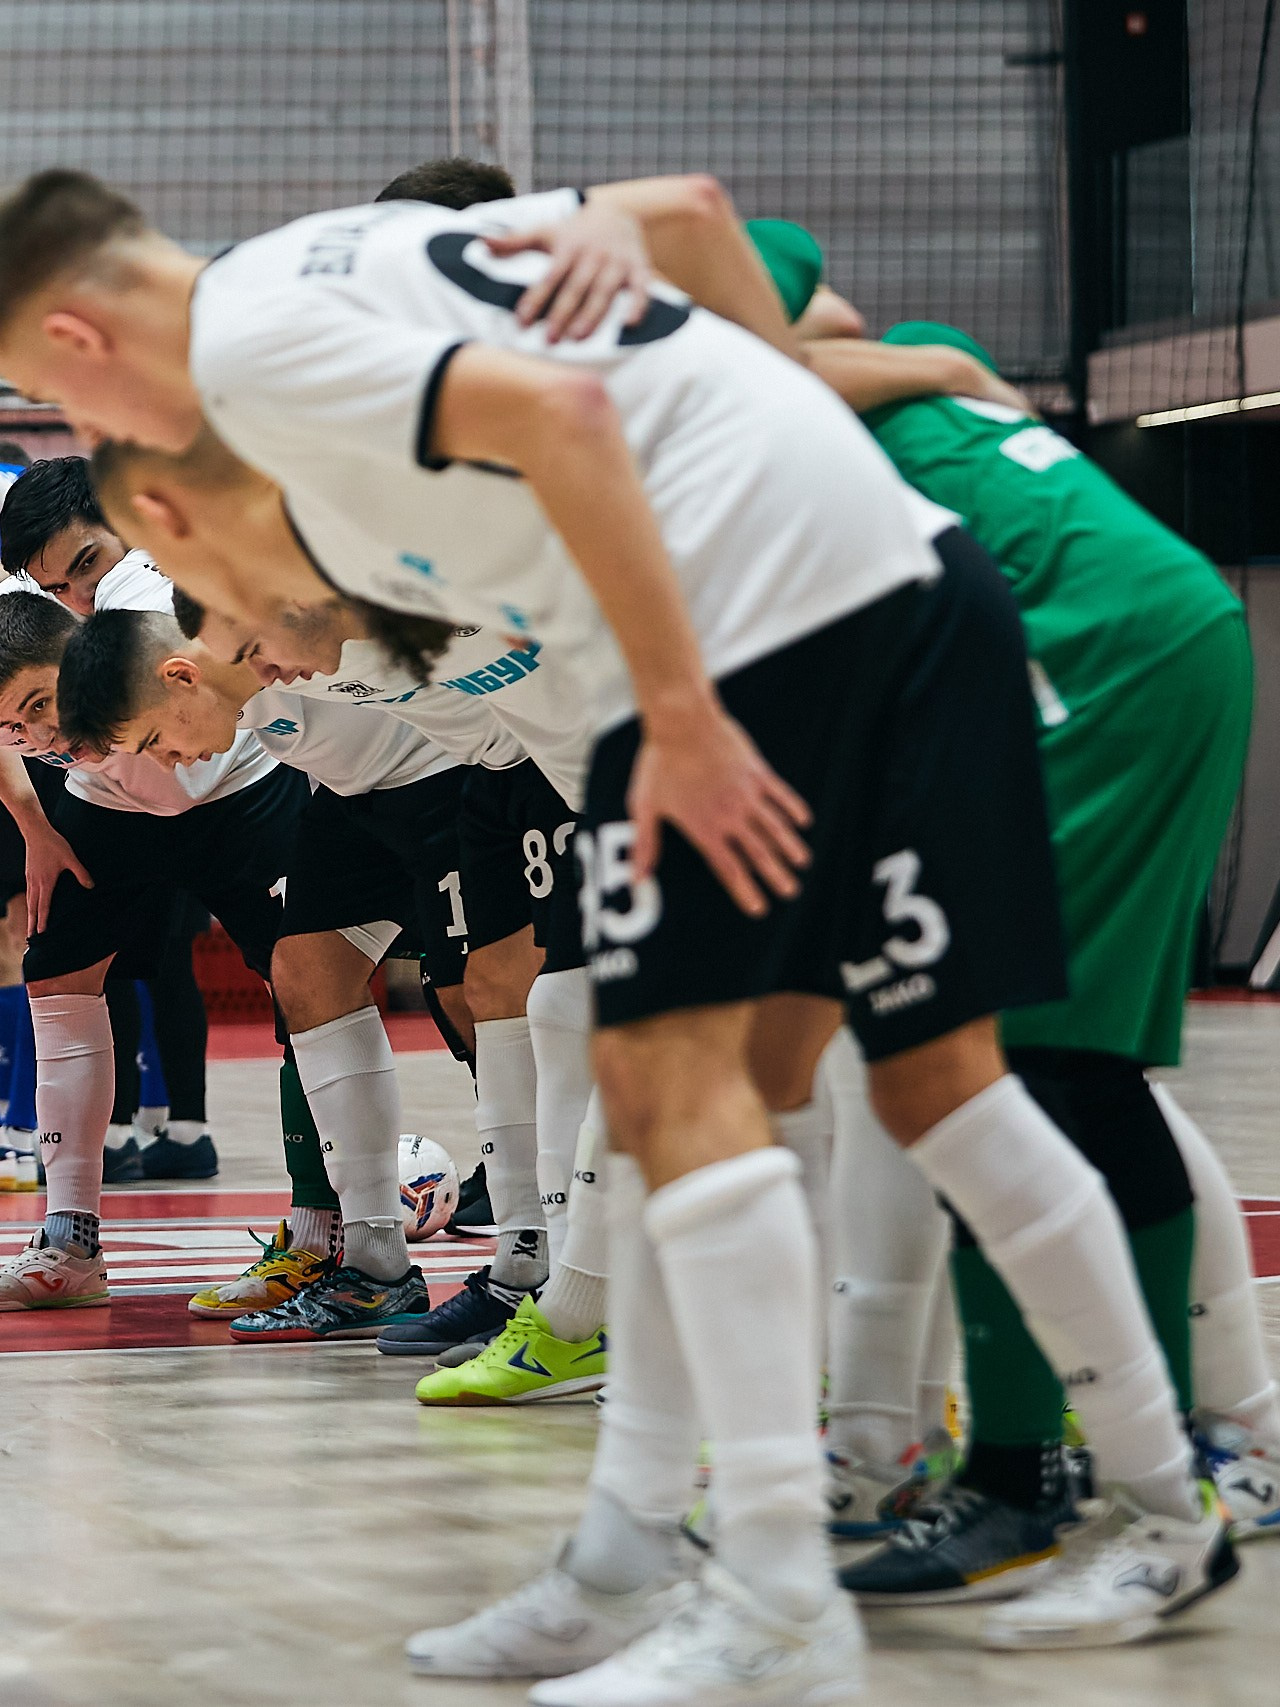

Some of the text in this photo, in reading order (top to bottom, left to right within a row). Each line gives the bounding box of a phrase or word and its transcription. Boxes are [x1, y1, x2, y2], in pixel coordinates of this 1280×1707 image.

[439, 641, 543, 696] ИБУР
[39, 1131, 62, 1145] AKO
[284, 1133, 304, 1144] KO
[574, 1169, 596, 1184] KO
[540, 1191, 567, 1206] AKO
